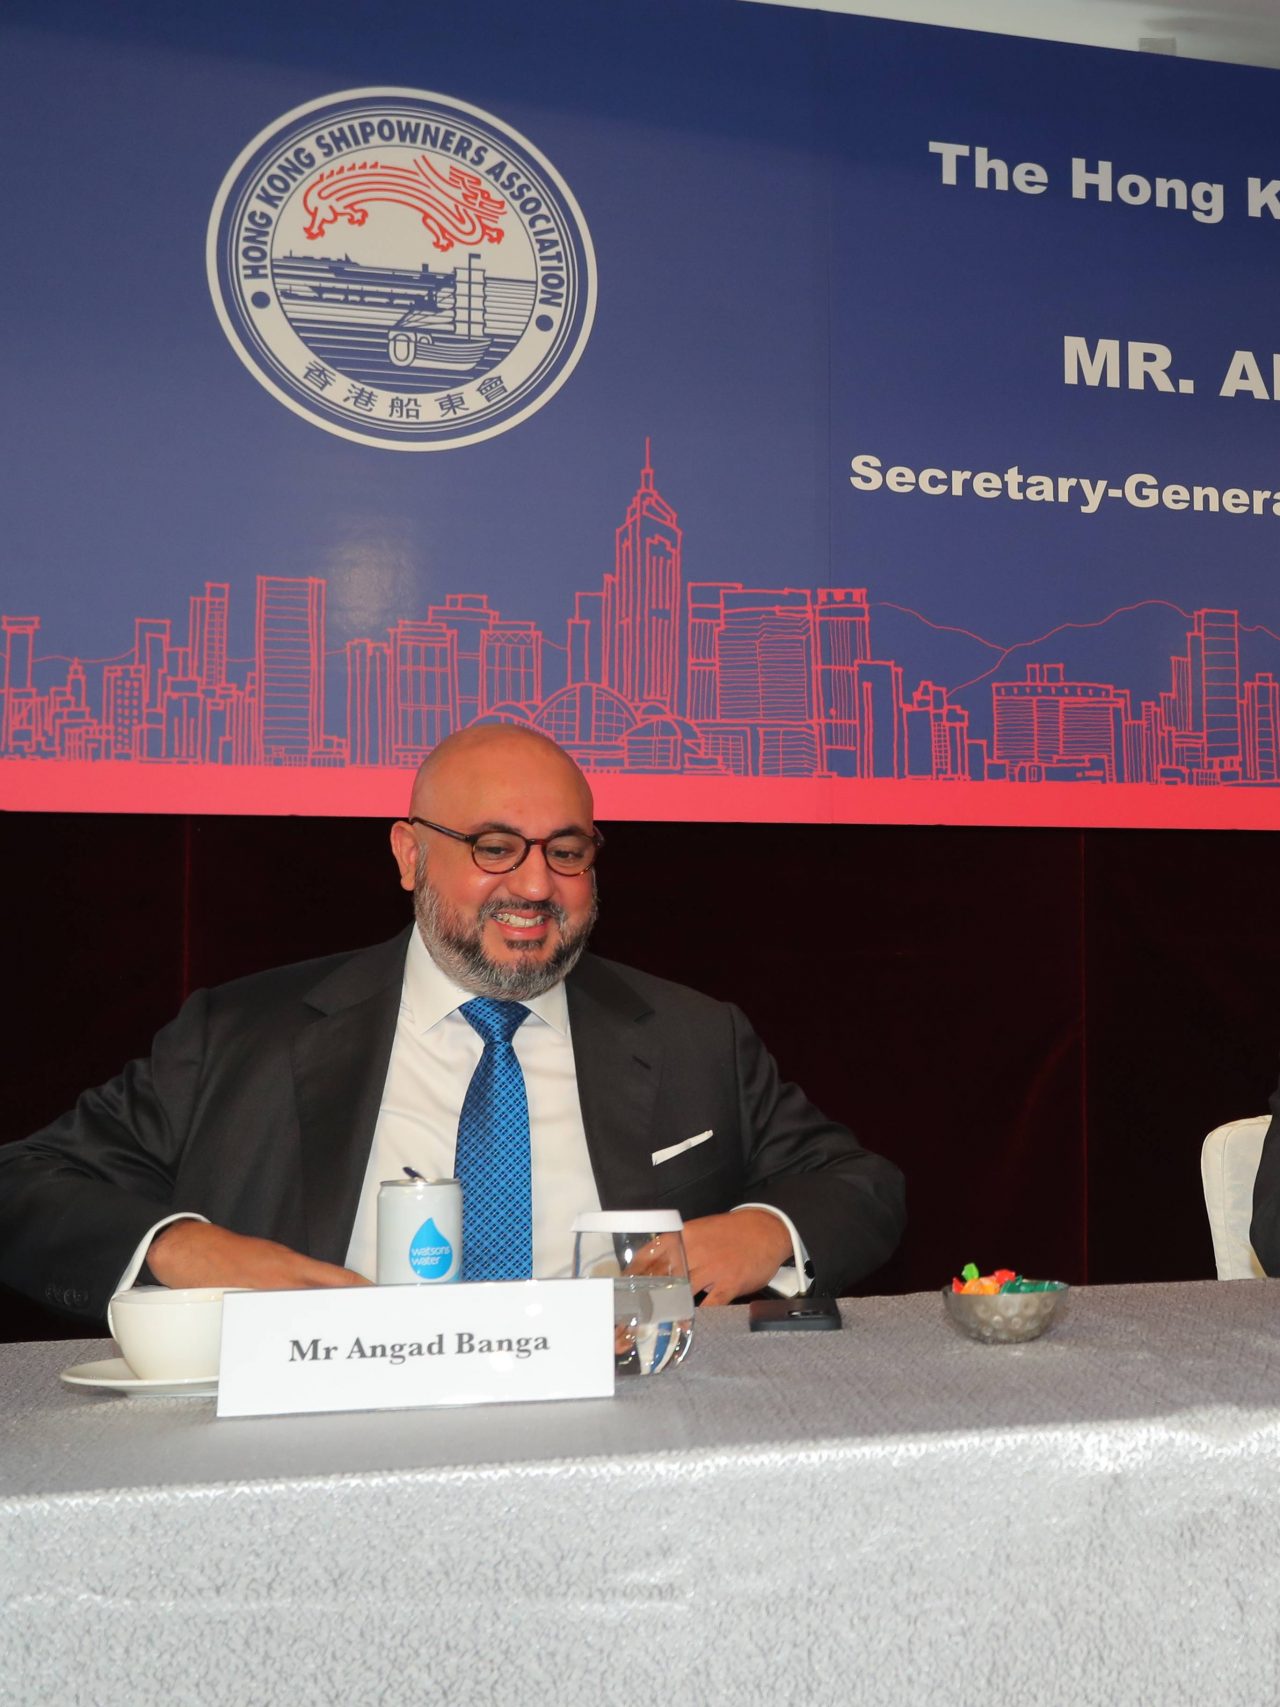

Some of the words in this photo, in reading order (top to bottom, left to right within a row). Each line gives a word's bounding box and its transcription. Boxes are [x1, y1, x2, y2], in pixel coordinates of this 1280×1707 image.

[928, 141, 1049, 195] The
[1071, 157, 1225, 224] Hong
[242, 210, 270, 279] HONG
[256, 147, 317, 211] KONG
[316, 119, 489, 167] SHIPOWNERS
[487, 159, 566, 308] ASSOCIATION
[303, 361, 508, 421] 香港船東會
[1063, 335, 1195, 394] MR.
[411, 1246, 451, 1257] watsons
[411, 1255, 441, 1266] water
[288, 1337, 338, 1363] Mr
[346, 1332, 445, 1365] Angad
[453, 1331, 551, 1360] Banga
